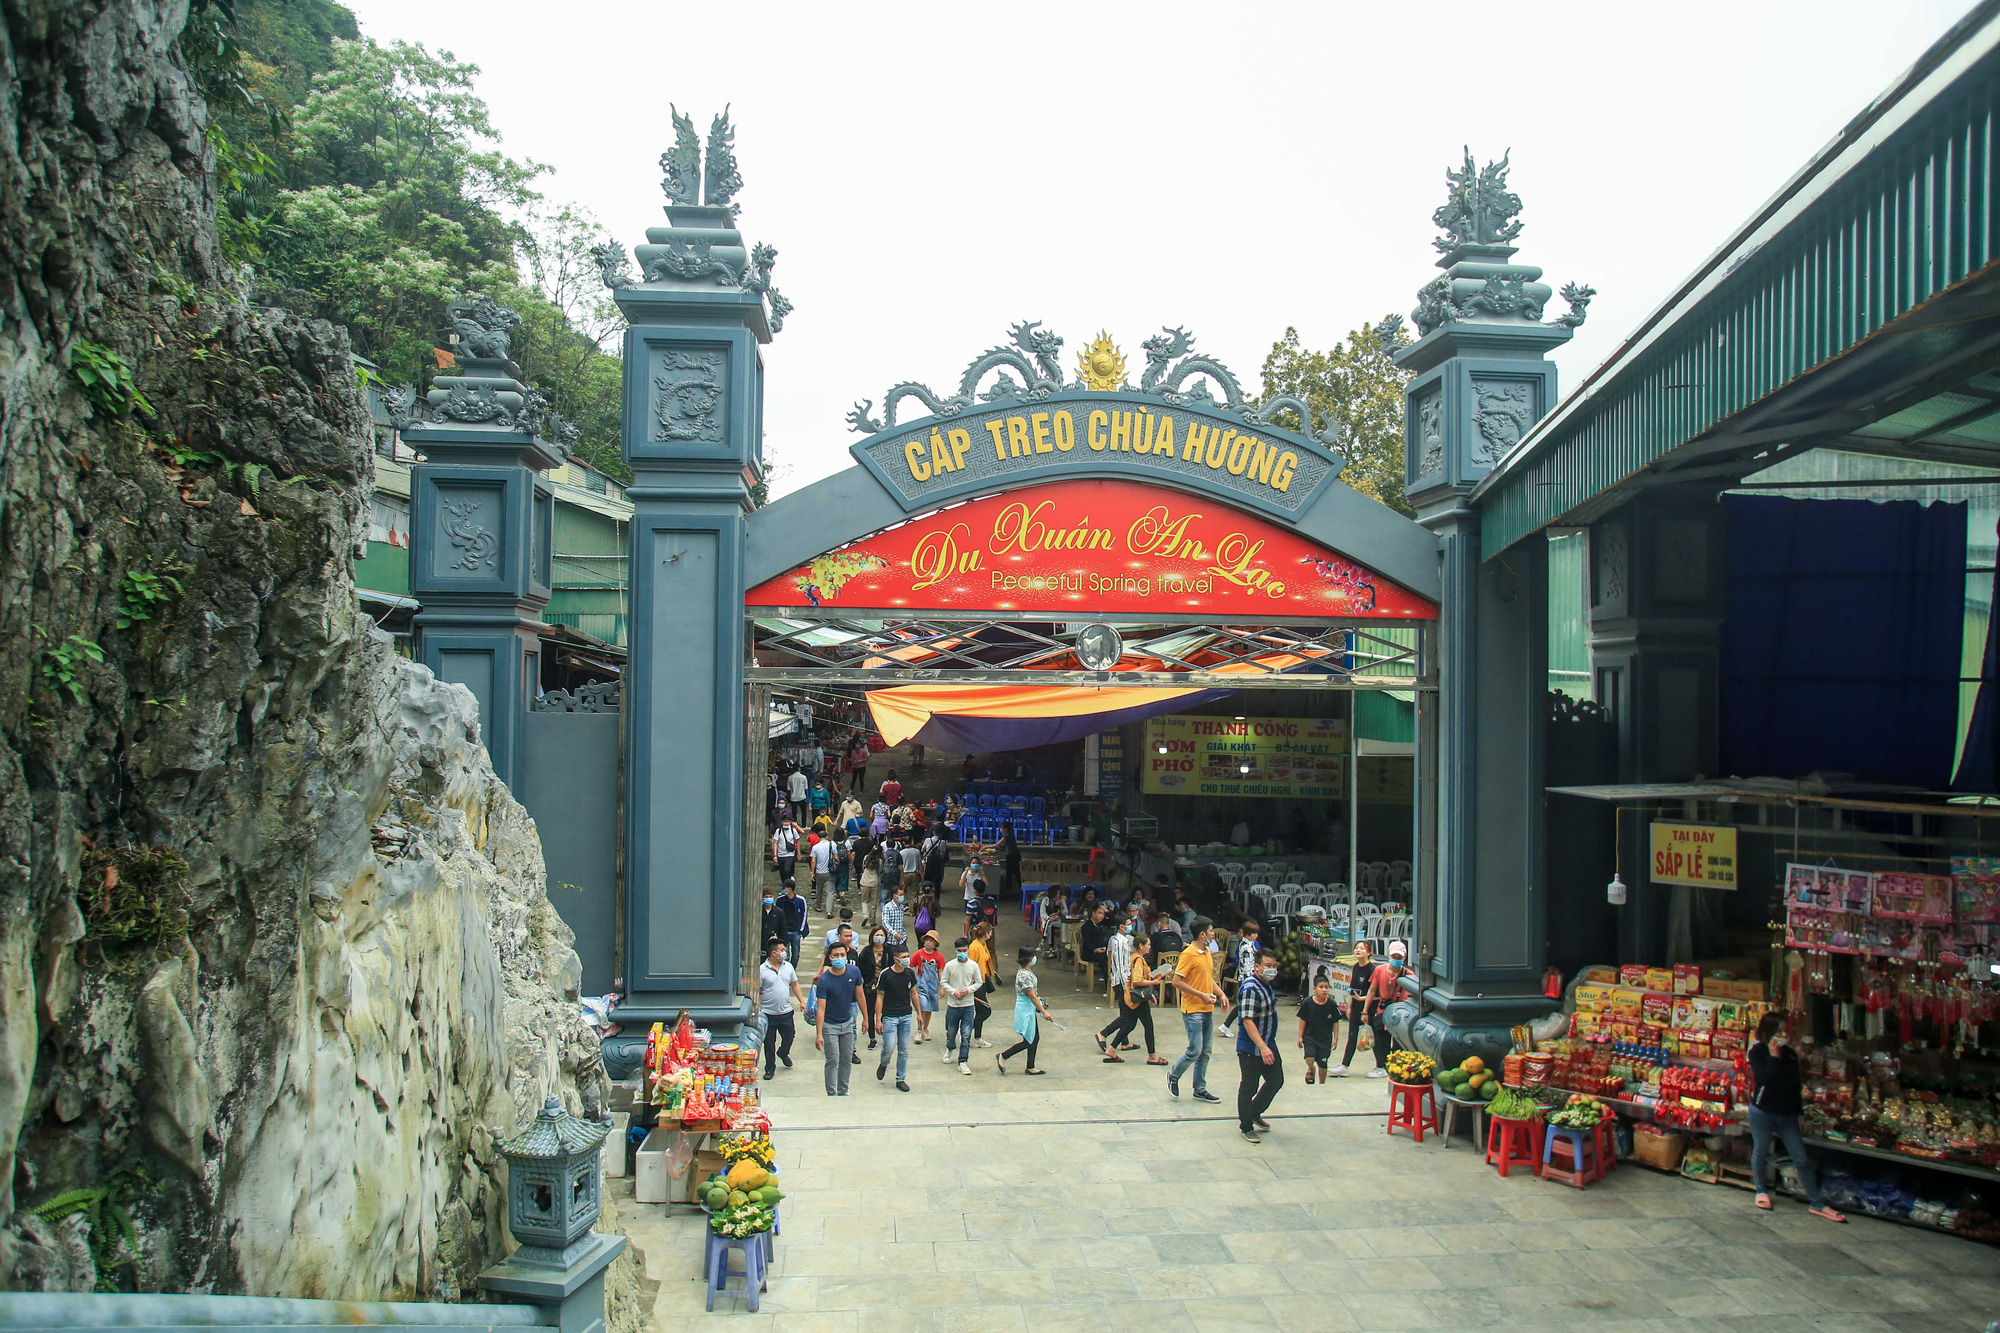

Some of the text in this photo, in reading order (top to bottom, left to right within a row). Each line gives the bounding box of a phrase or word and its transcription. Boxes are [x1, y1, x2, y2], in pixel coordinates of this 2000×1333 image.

[904, 407, 1299, 493] CÁP TREO CHÙA HƯƠNG
[911, 500, 1286, 599] Du Xuân An Lạc
[991, 571, 1214, 597] Peaceful Spring travel
[1192, 719, 1298, 737] THANH CÔNG
[1151, 755, 1195, 772] PHỞ
[1200, 784, 1217, 793] CHO
[1672, 830, 1715, 843] TẠI ĐÂY
[1655, 843, 1683, 877] SẮP
[1687, 845, 1703, 878] LỄ
[1578, 991, 1598, 999] Star
